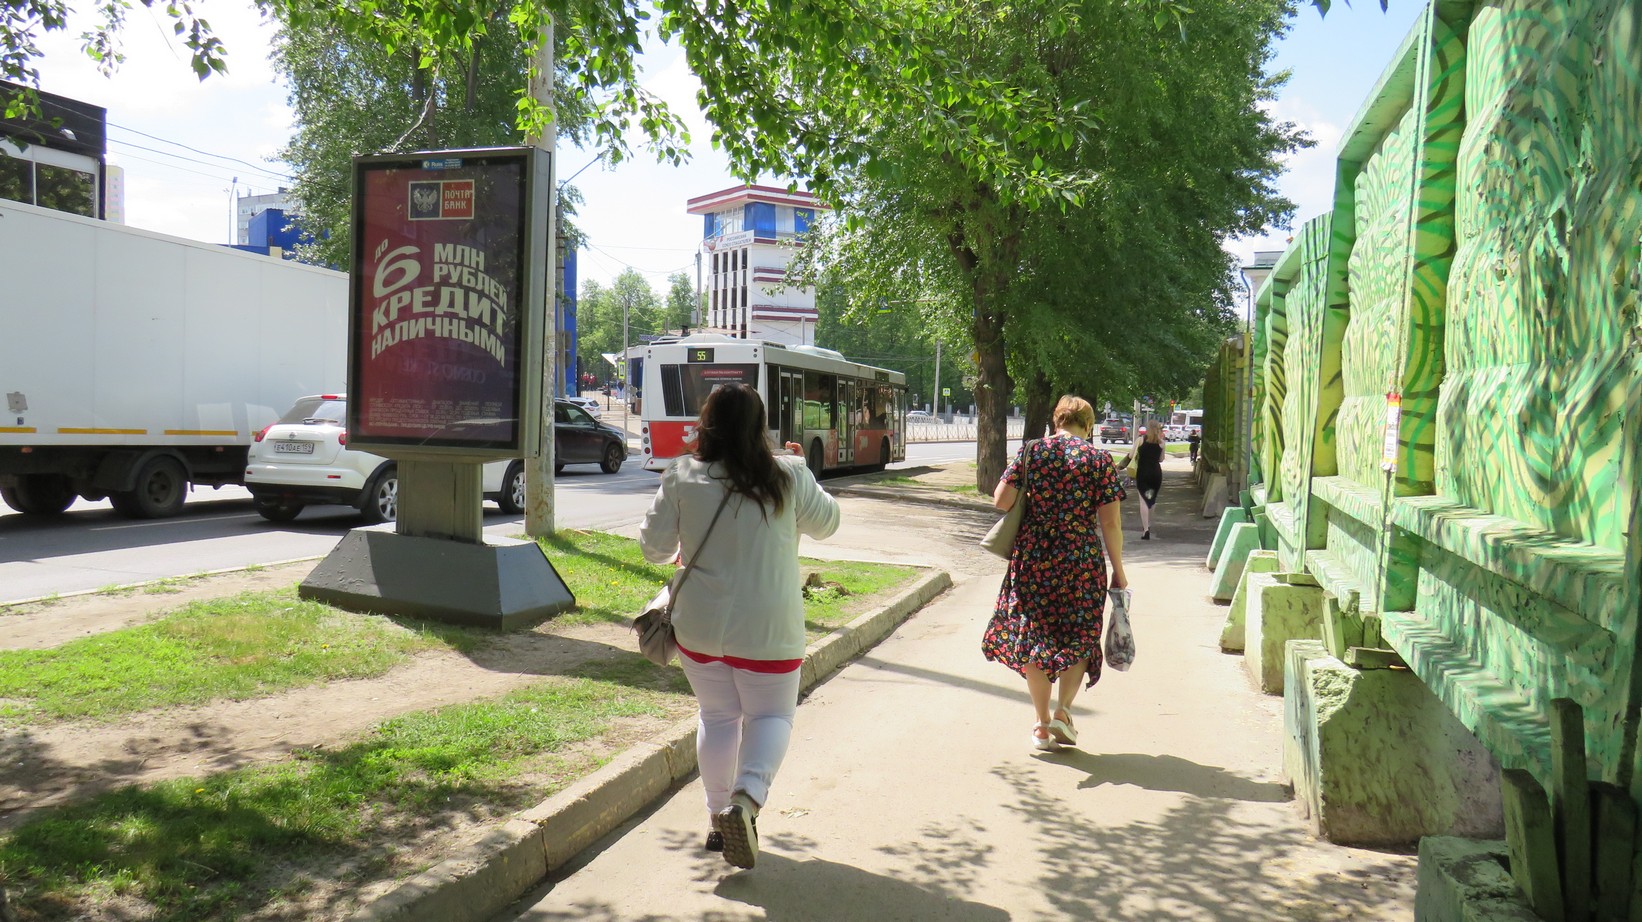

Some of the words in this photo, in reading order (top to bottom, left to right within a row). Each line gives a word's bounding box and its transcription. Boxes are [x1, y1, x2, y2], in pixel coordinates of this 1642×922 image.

[444, 189, 471, 199] ПОЧТА
[444, 200, 467, 209] БАНК
[374, 239, 389, 263] ДО
[434, 243, 485, 272] МЛН
[373, 246, 421, 298] 6
[433, 263, 507, 313] РУБЛЕЙ
[372, 286, 507, 337] КРЕДИТ
[371, 316, 506, 368] НАЛИЧНЫМИ
[697, 351, 706, 361] 55
